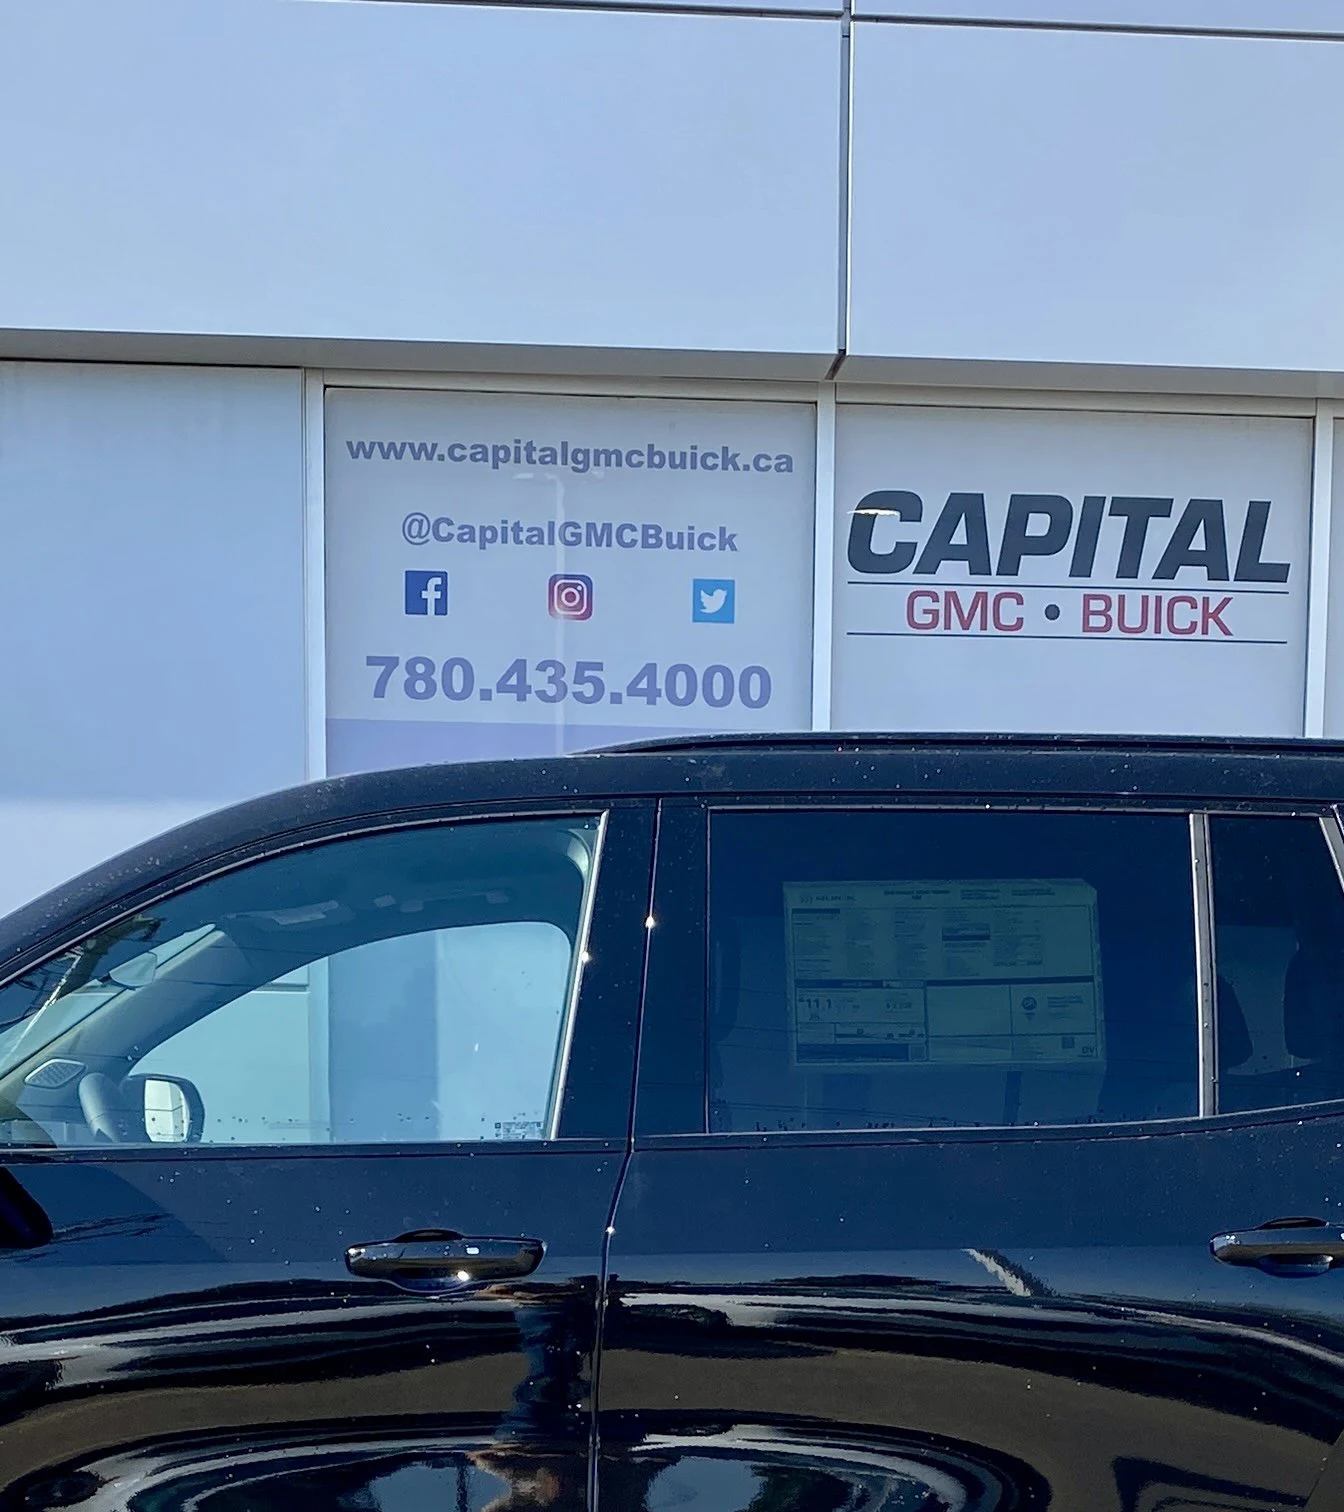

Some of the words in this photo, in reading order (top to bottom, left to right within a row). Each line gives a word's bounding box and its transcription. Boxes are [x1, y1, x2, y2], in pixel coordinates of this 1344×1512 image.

[345, 438, 794, 474] www.capitalgmcbuick.ca
[401, 511, 739, 552] @CapitalGMCBuick
[847, 490, 1291, 583] CAPITAL
[905, 589, 1025, 631] GMC
[1081, 593, 1234, 637] BUICK
[365, 655, 773, 710] 780.435.4000
